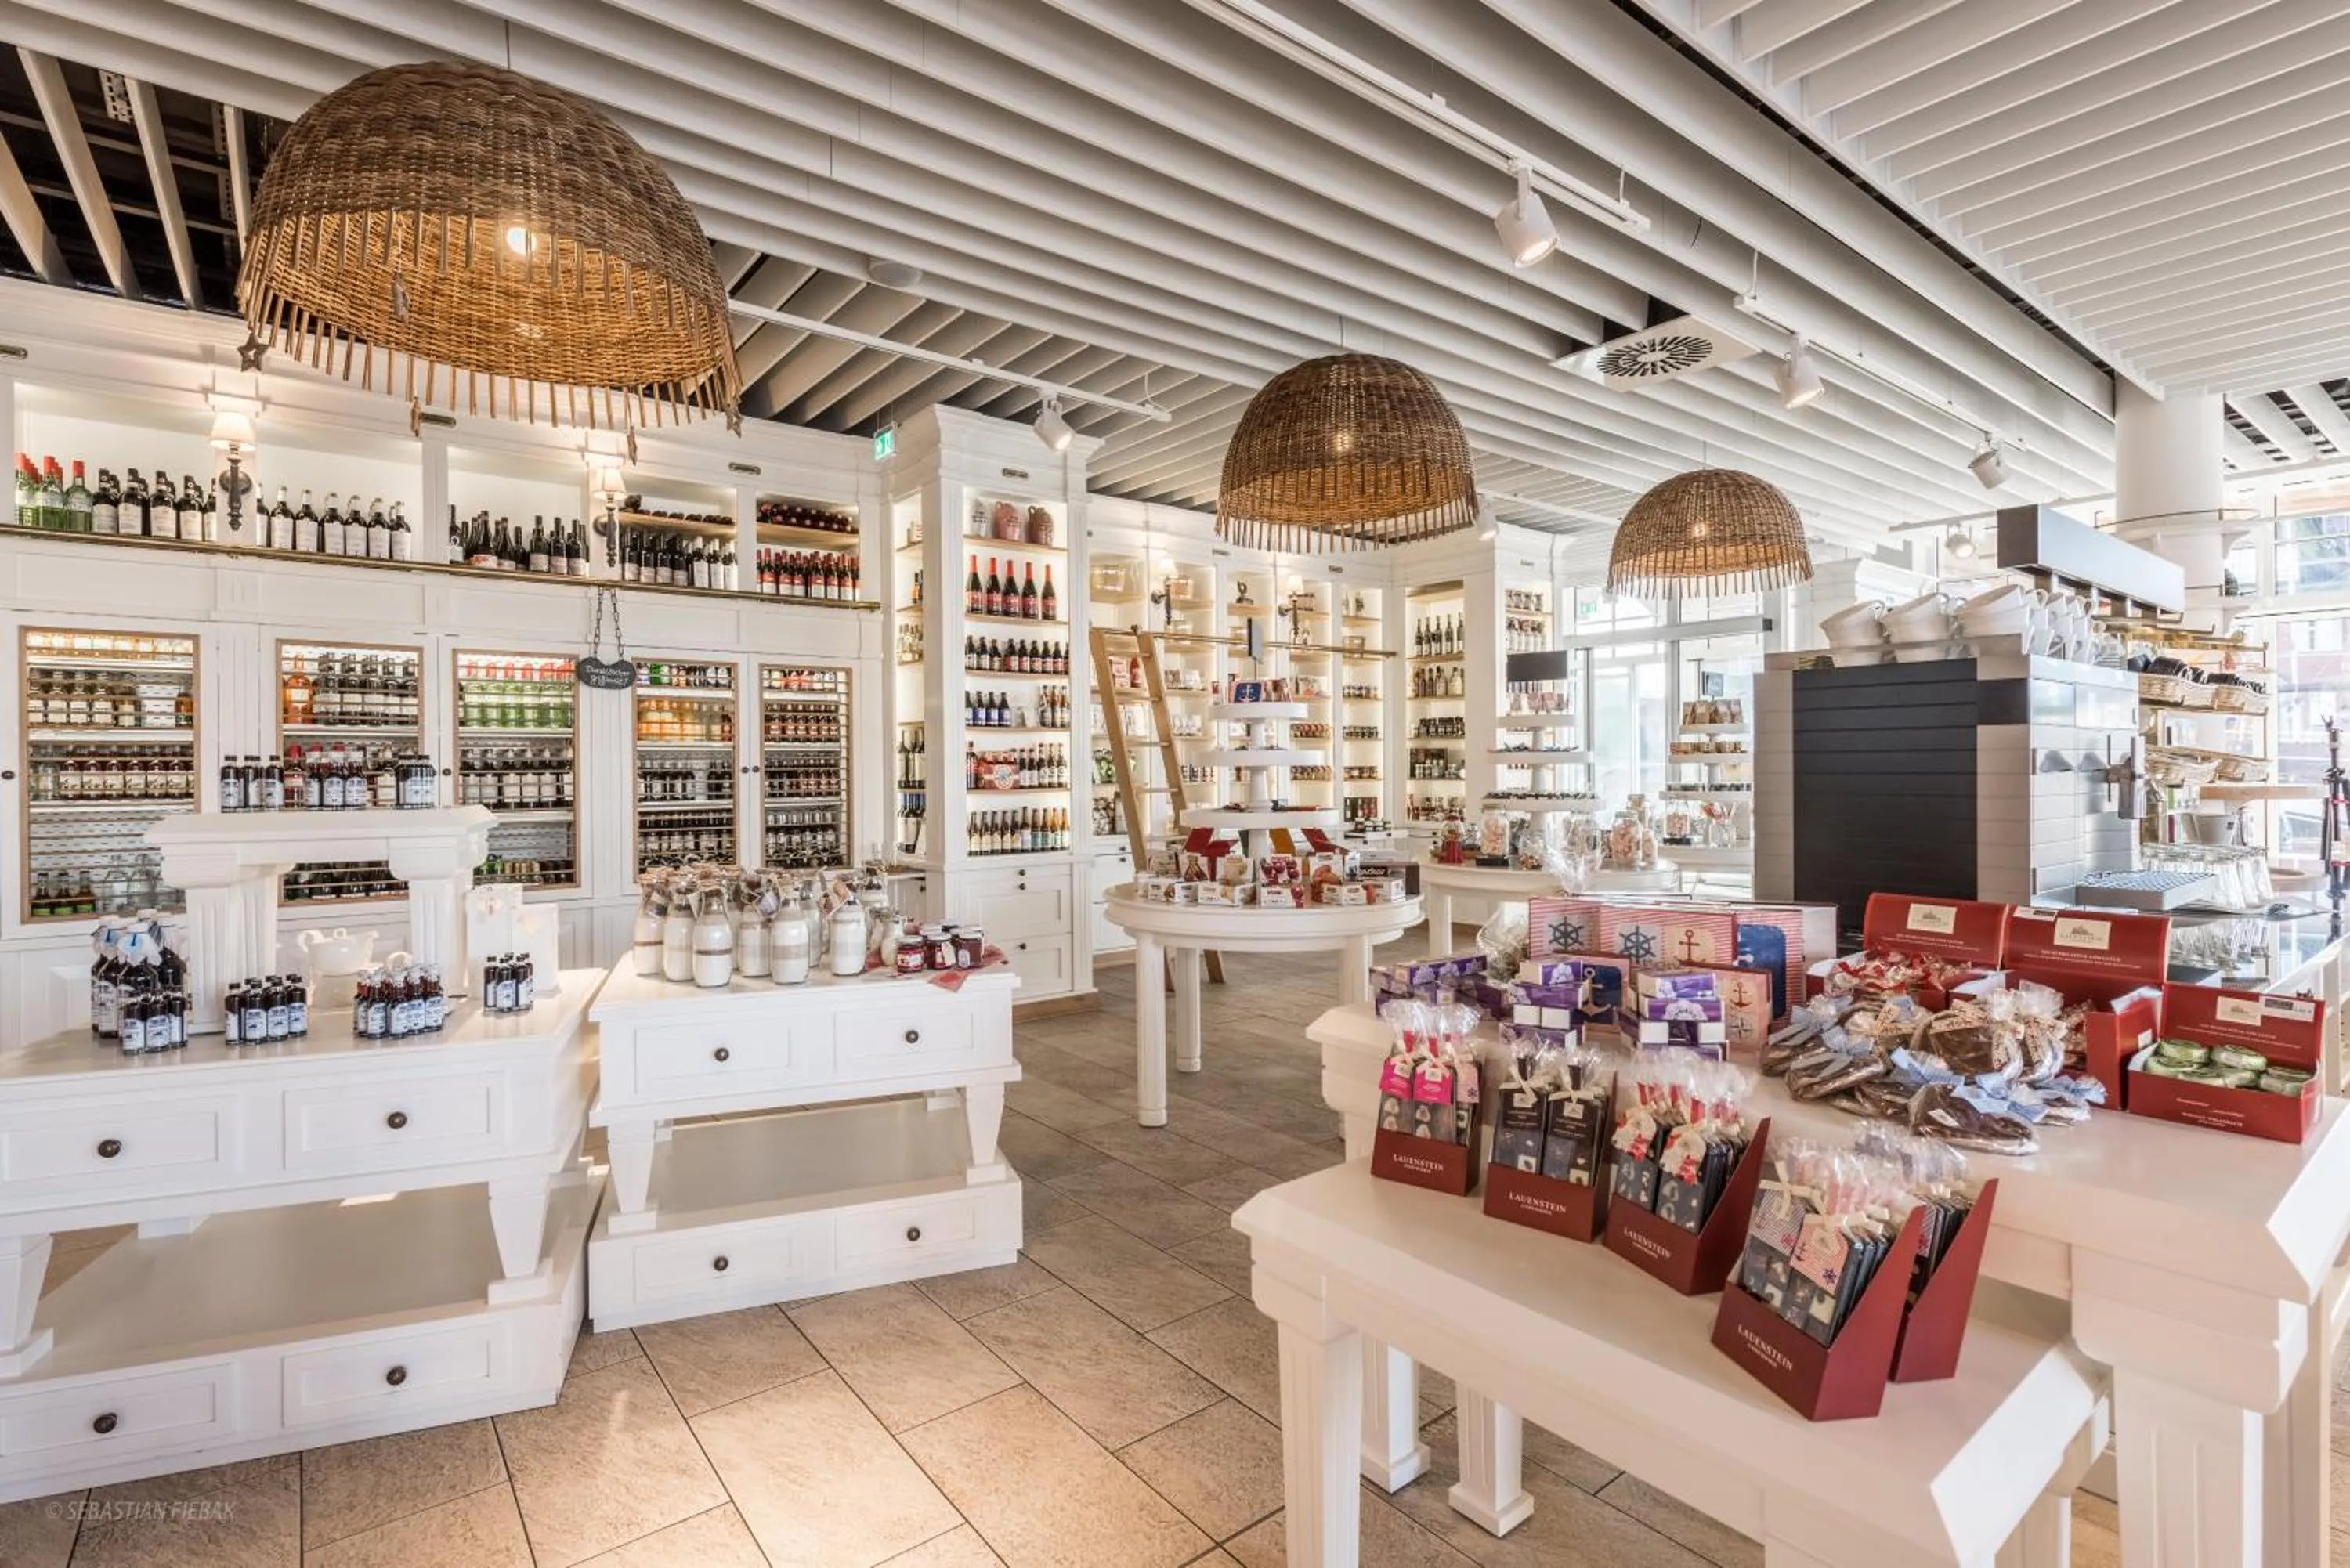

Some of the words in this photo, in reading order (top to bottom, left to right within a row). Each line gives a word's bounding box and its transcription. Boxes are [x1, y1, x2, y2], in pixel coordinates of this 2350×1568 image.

[1394, 1154, 1444, 1172] LAUENSTEIN
[1509, 1191, 1566, 1213] LAUENSTEIN
[1624, 1227, 1671, 1258] LAUENSTEIN
[1738, 1324, 1792, 1371] LAUENSTEIN
